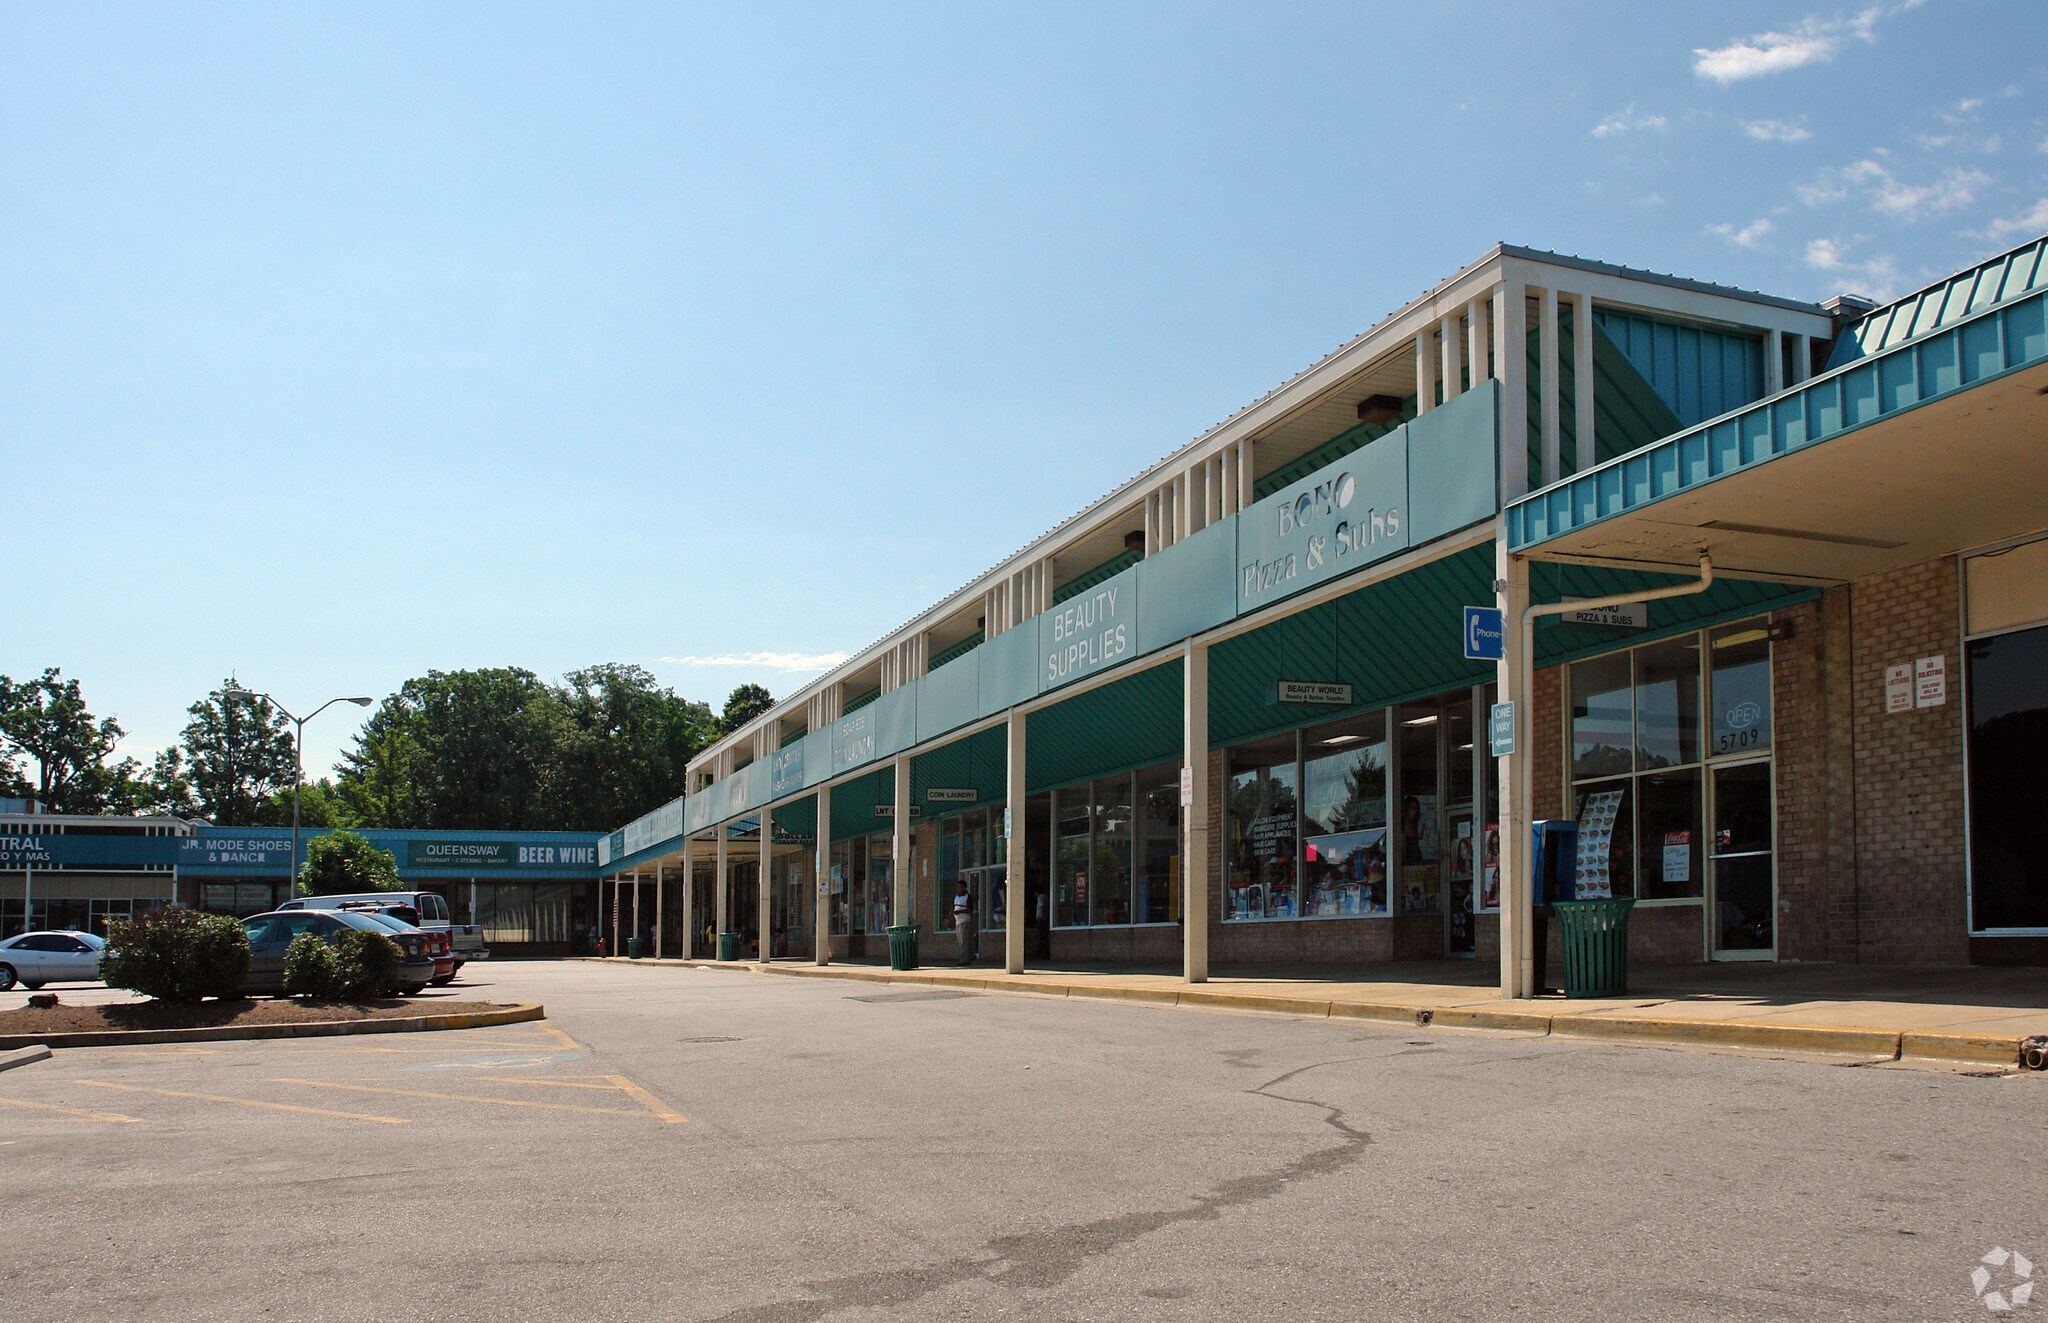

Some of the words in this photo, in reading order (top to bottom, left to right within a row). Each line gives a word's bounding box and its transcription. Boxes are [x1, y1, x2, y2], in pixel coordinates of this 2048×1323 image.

[1277, 472, 1356, 538] BONO
[1243, 553, 1296, 598] Pizza
[1306, 535, 1326, 571] &
[1054, 587, 1118, 642] BEAUTY
[1590, 604, 1618, 613] ONO
[1576, 612, 1600, 623] PIZZA
[1602, 614, 1608, 623] &
[1611, 615, 1633, 625] SUBS
[1476, 628, 1499, 638] Phone
[1048, 624, 1126, 681] SUPPLIES
[1287, 684, 1316, 694] BEAUTY
[1318, 686, 1344, 695] WORLD
[1495, 706, 1511, 719] ONE
[1726, 705, 1761, 724] OPEN
[1496, 721, 1511, 733] WAY
[1721, 728, 1759, 750] 5709
[0, 837, 44, 850] TRAL
[182, 839, 202, 850] JR.
[206, 840, 244, 850] MODE
[247, 840, 292, 851] SHOES
[426, 844, 500, 856] QUEENSWAY
[14, 852, 22, 860] Y
[26, 852, 51, 861] MAS
[208, 852, 217, 862] &
[221, 852, 266, 862] DANCE
[519, 846, 554, 863] BEER
[559, 847, 595, 863] WINE
